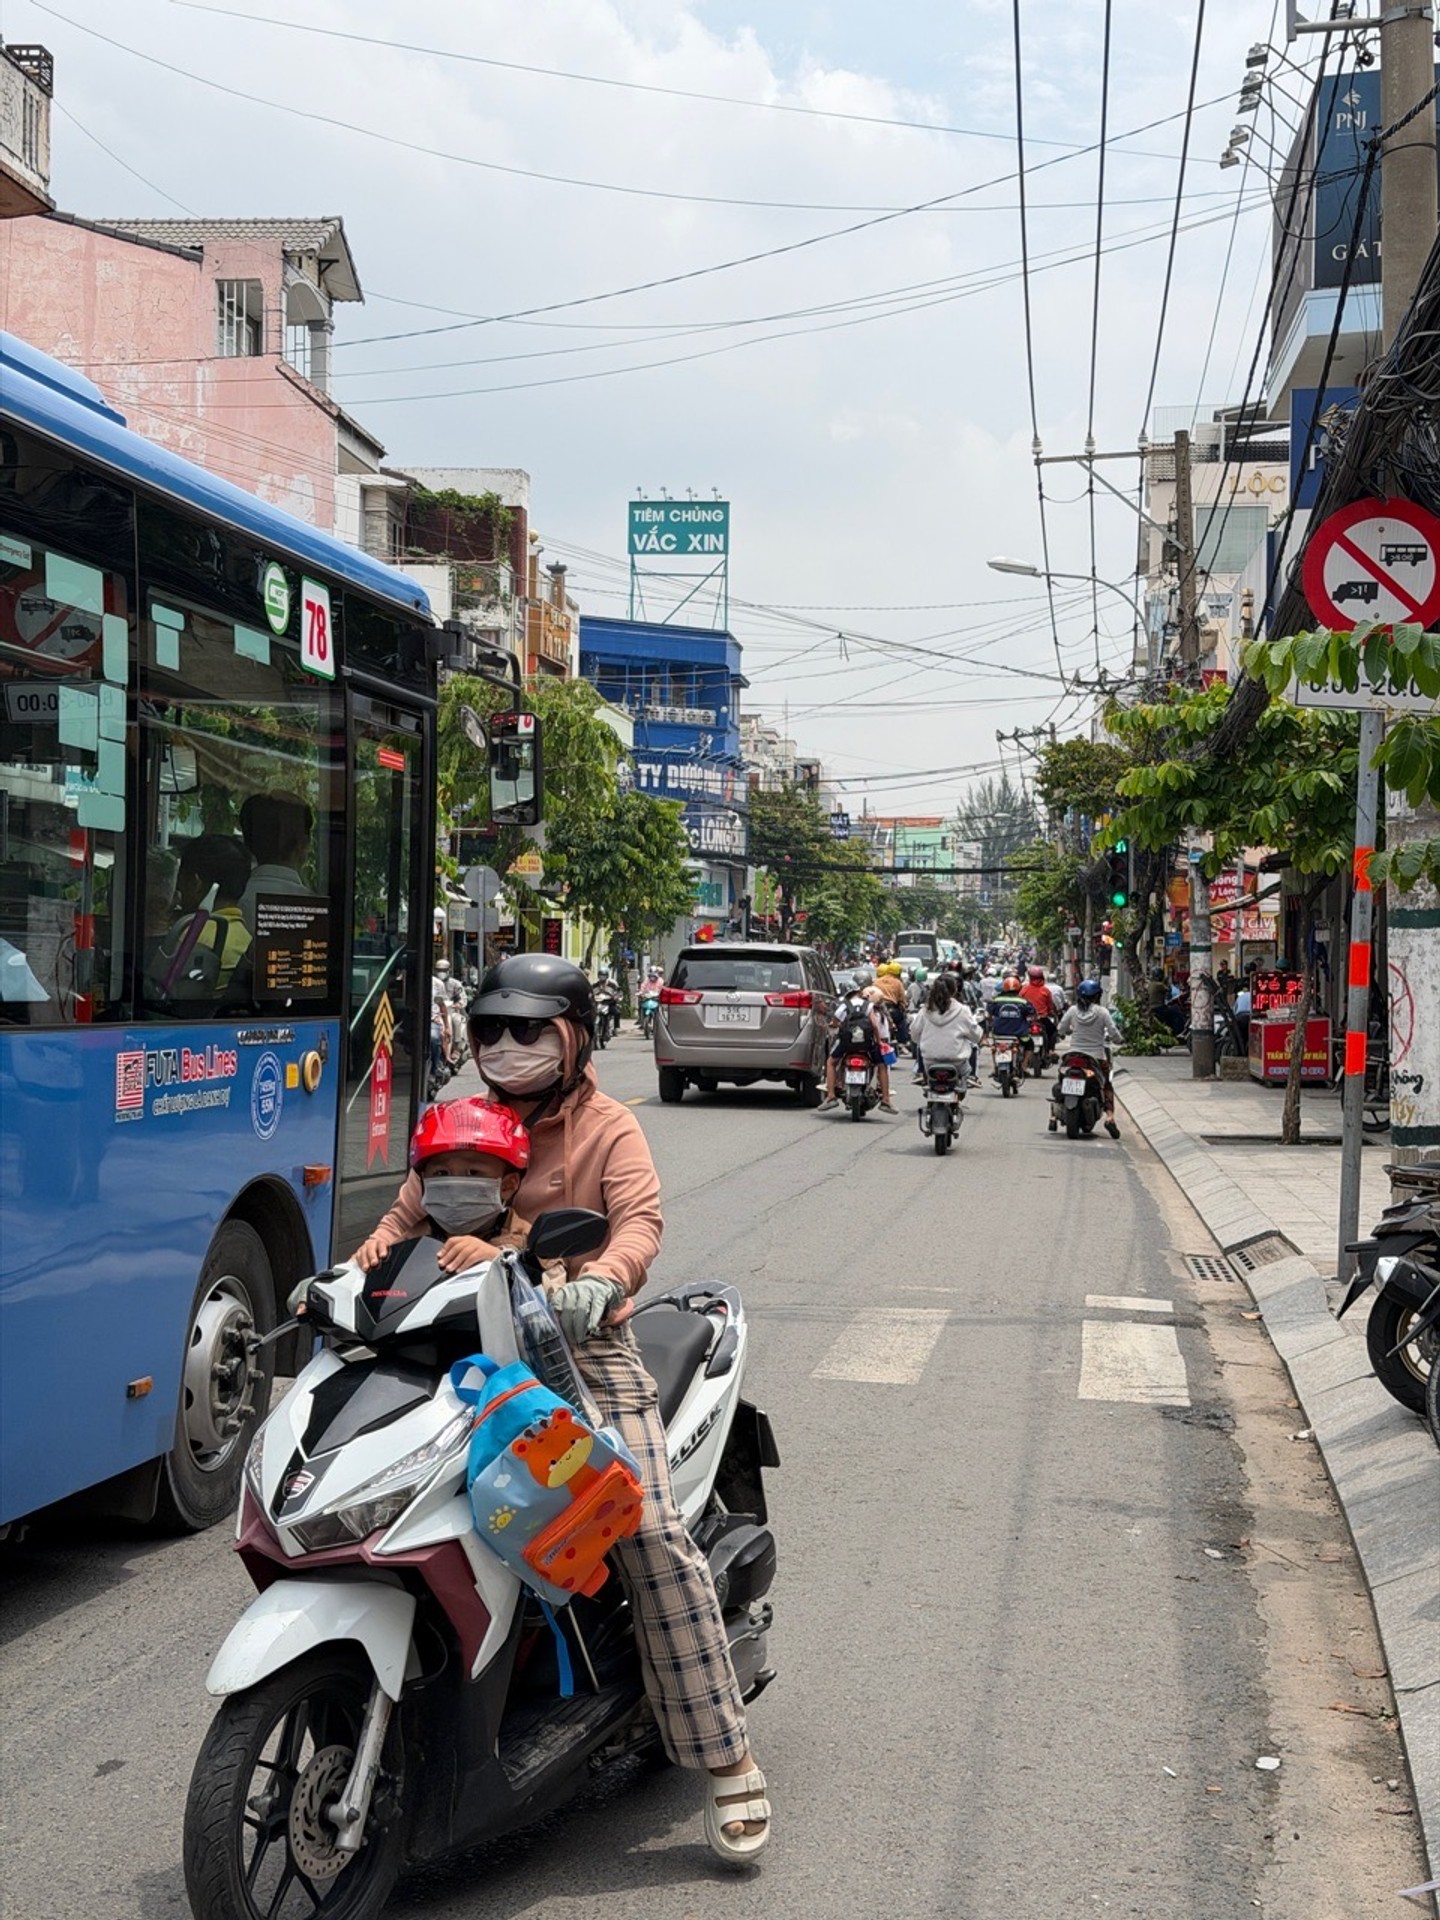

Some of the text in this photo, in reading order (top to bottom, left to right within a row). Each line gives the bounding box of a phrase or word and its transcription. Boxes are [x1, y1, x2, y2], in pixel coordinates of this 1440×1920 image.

[1336, 111, 1367, 131] PNJ
[1229, 471, 1287, 498] LỘC
[633, 505, 724, 522] TIÊM CHỦNG
[633, 525, 724, 551] VẮC XIN
[305, 599, 327, 661] 78
[638, 763, 662, 788] TY
[145, 1044, 238, 1089] FUTA Bus Lines
